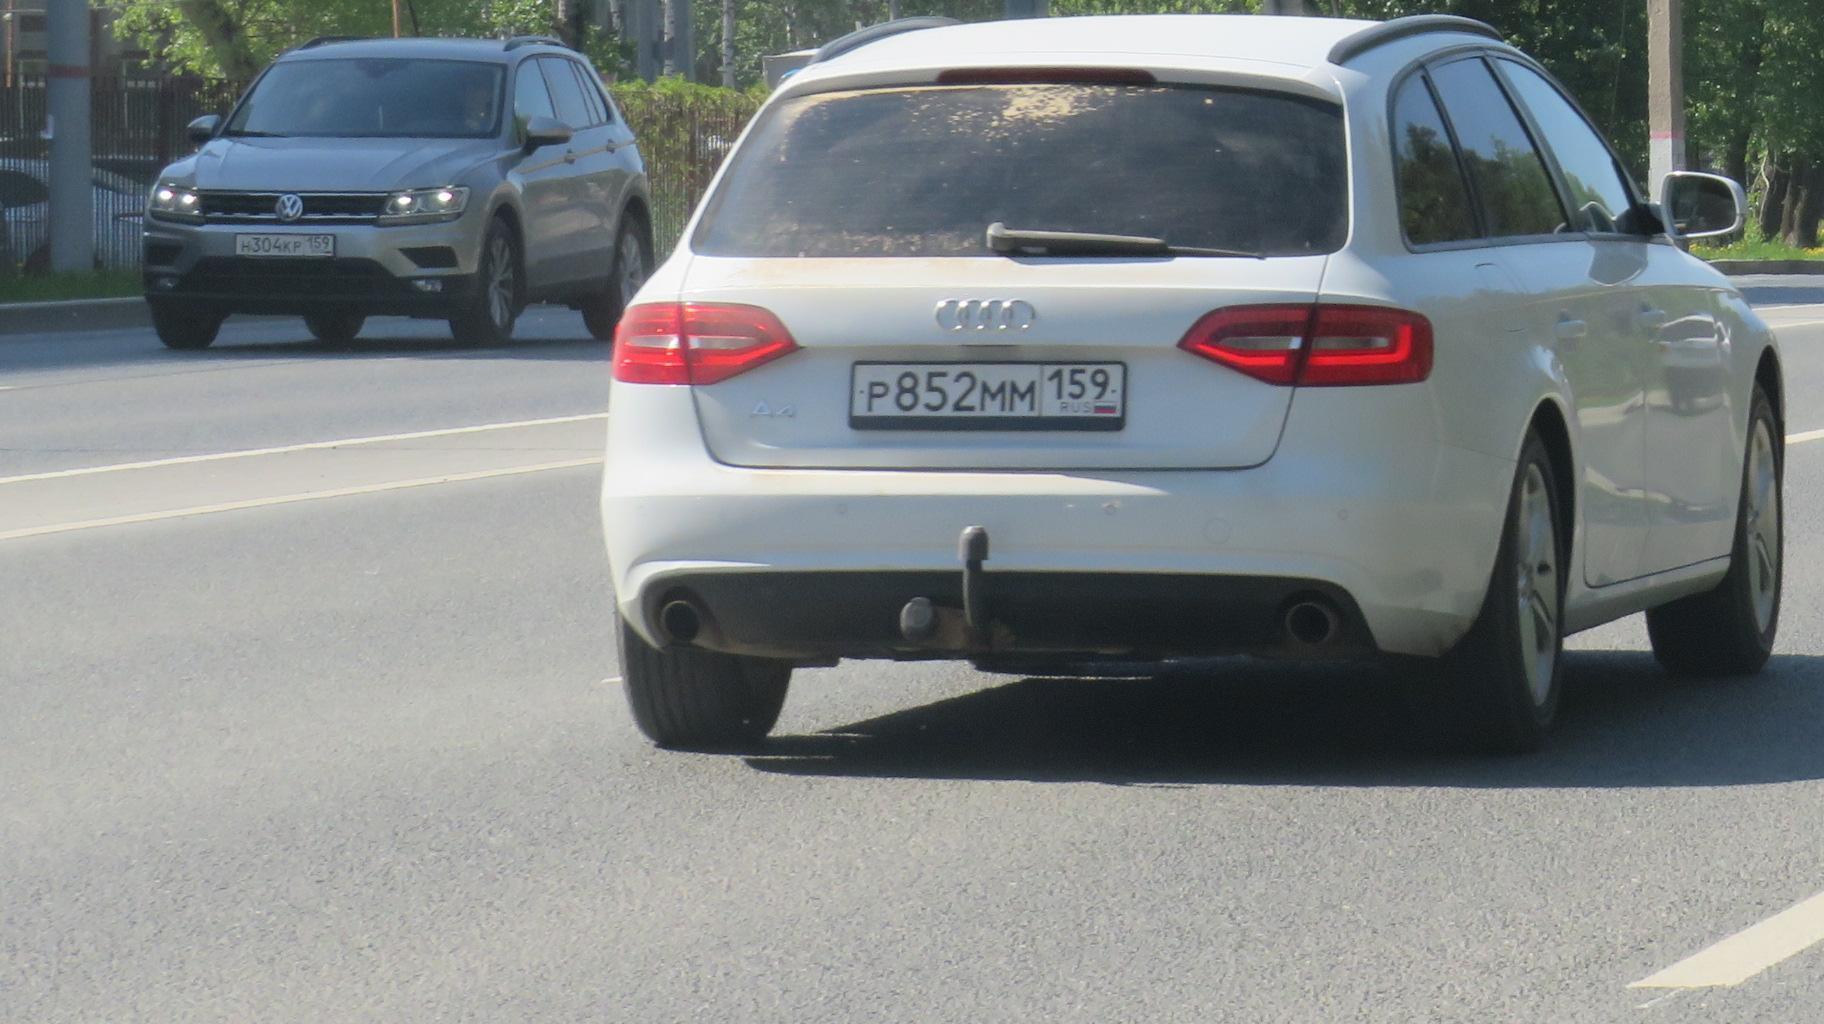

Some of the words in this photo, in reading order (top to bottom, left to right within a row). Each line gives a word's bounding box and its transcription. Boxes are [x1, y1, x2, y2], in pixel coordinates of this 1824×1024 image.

[306, 236, 330, 250] 159
[867, 371, 1036, 413] Р852ММ
[1047, 369, 1110, 400] 159
